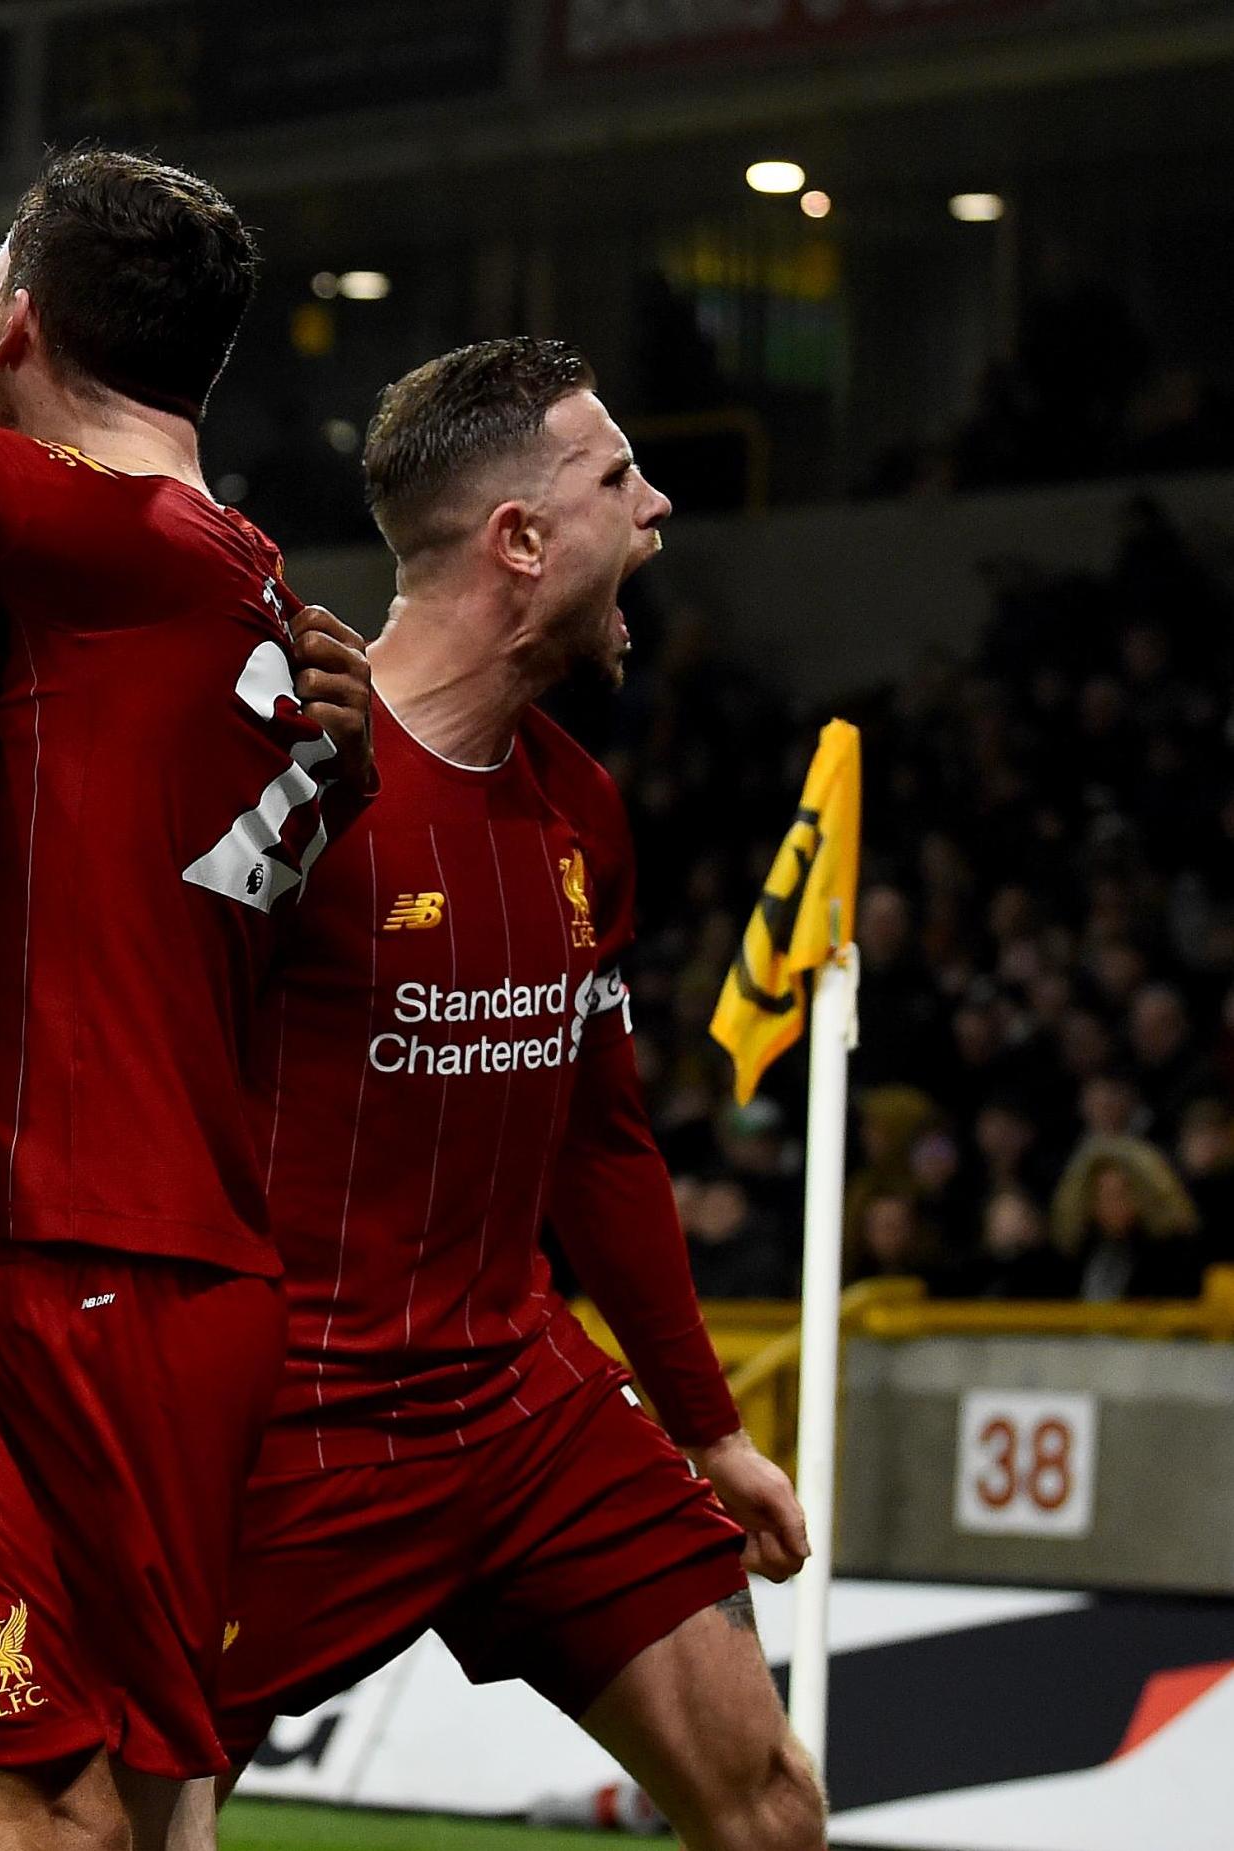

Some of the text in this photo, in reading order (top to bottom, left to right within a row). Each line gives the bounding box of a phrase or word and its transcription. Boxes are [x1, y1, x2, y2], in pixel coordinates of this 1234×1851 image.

[393, 972, 567, 1023] Standard
[368, 1026, 563, 1076] Chartered
[976, 1418, 1073, 1515] 38
